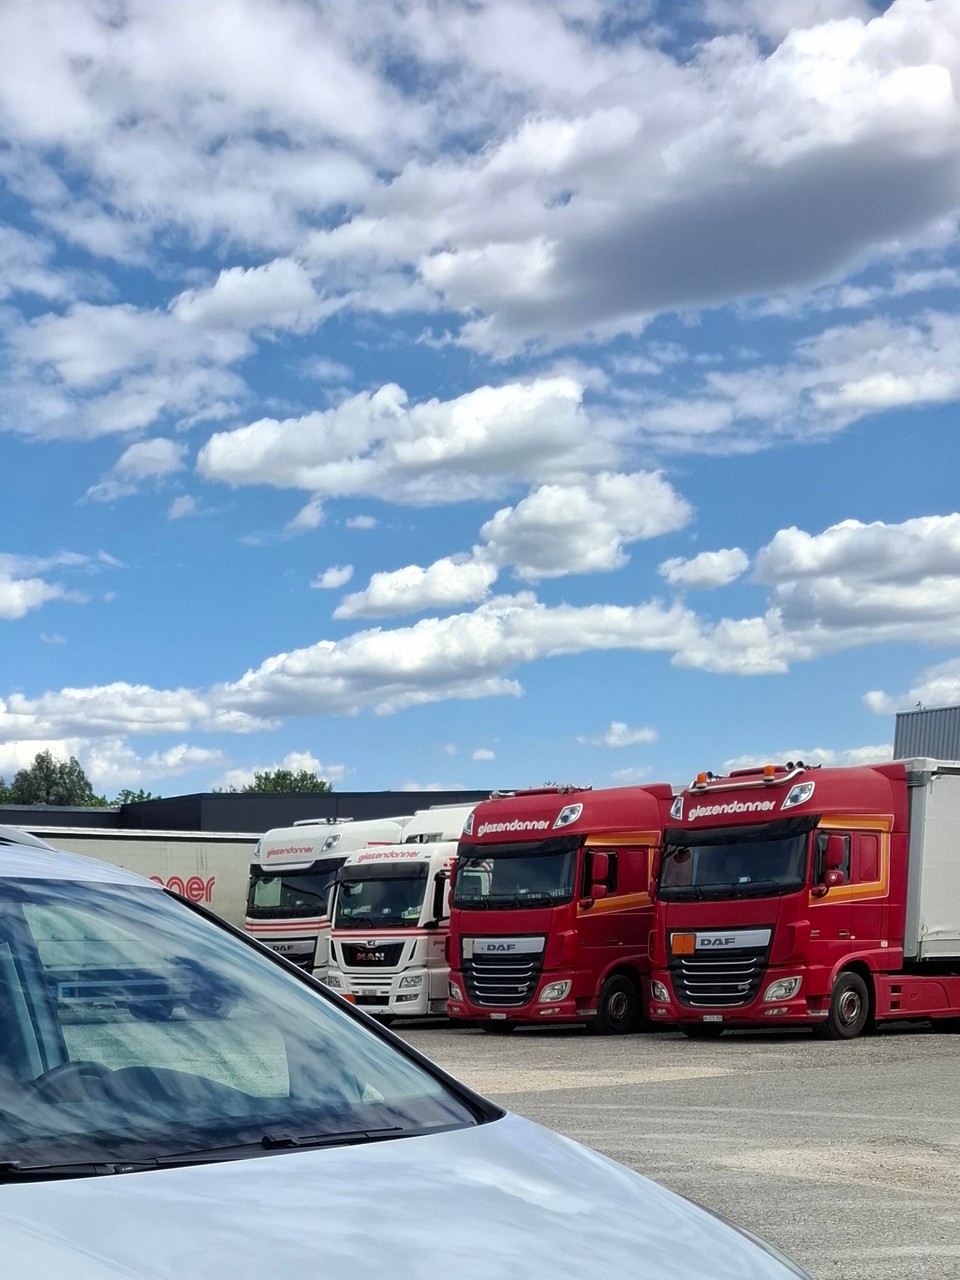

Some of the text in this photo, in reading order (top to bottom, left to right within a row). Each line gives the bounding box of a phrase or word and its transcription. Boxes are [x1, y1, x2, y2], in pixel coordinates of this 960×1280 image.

[687, 800, 777, 822] giezendanner
[477, 819, 550, 837] giezendanner
[700, 937, 736, 946] DAF
[356, 952, 385, 961] MAN
